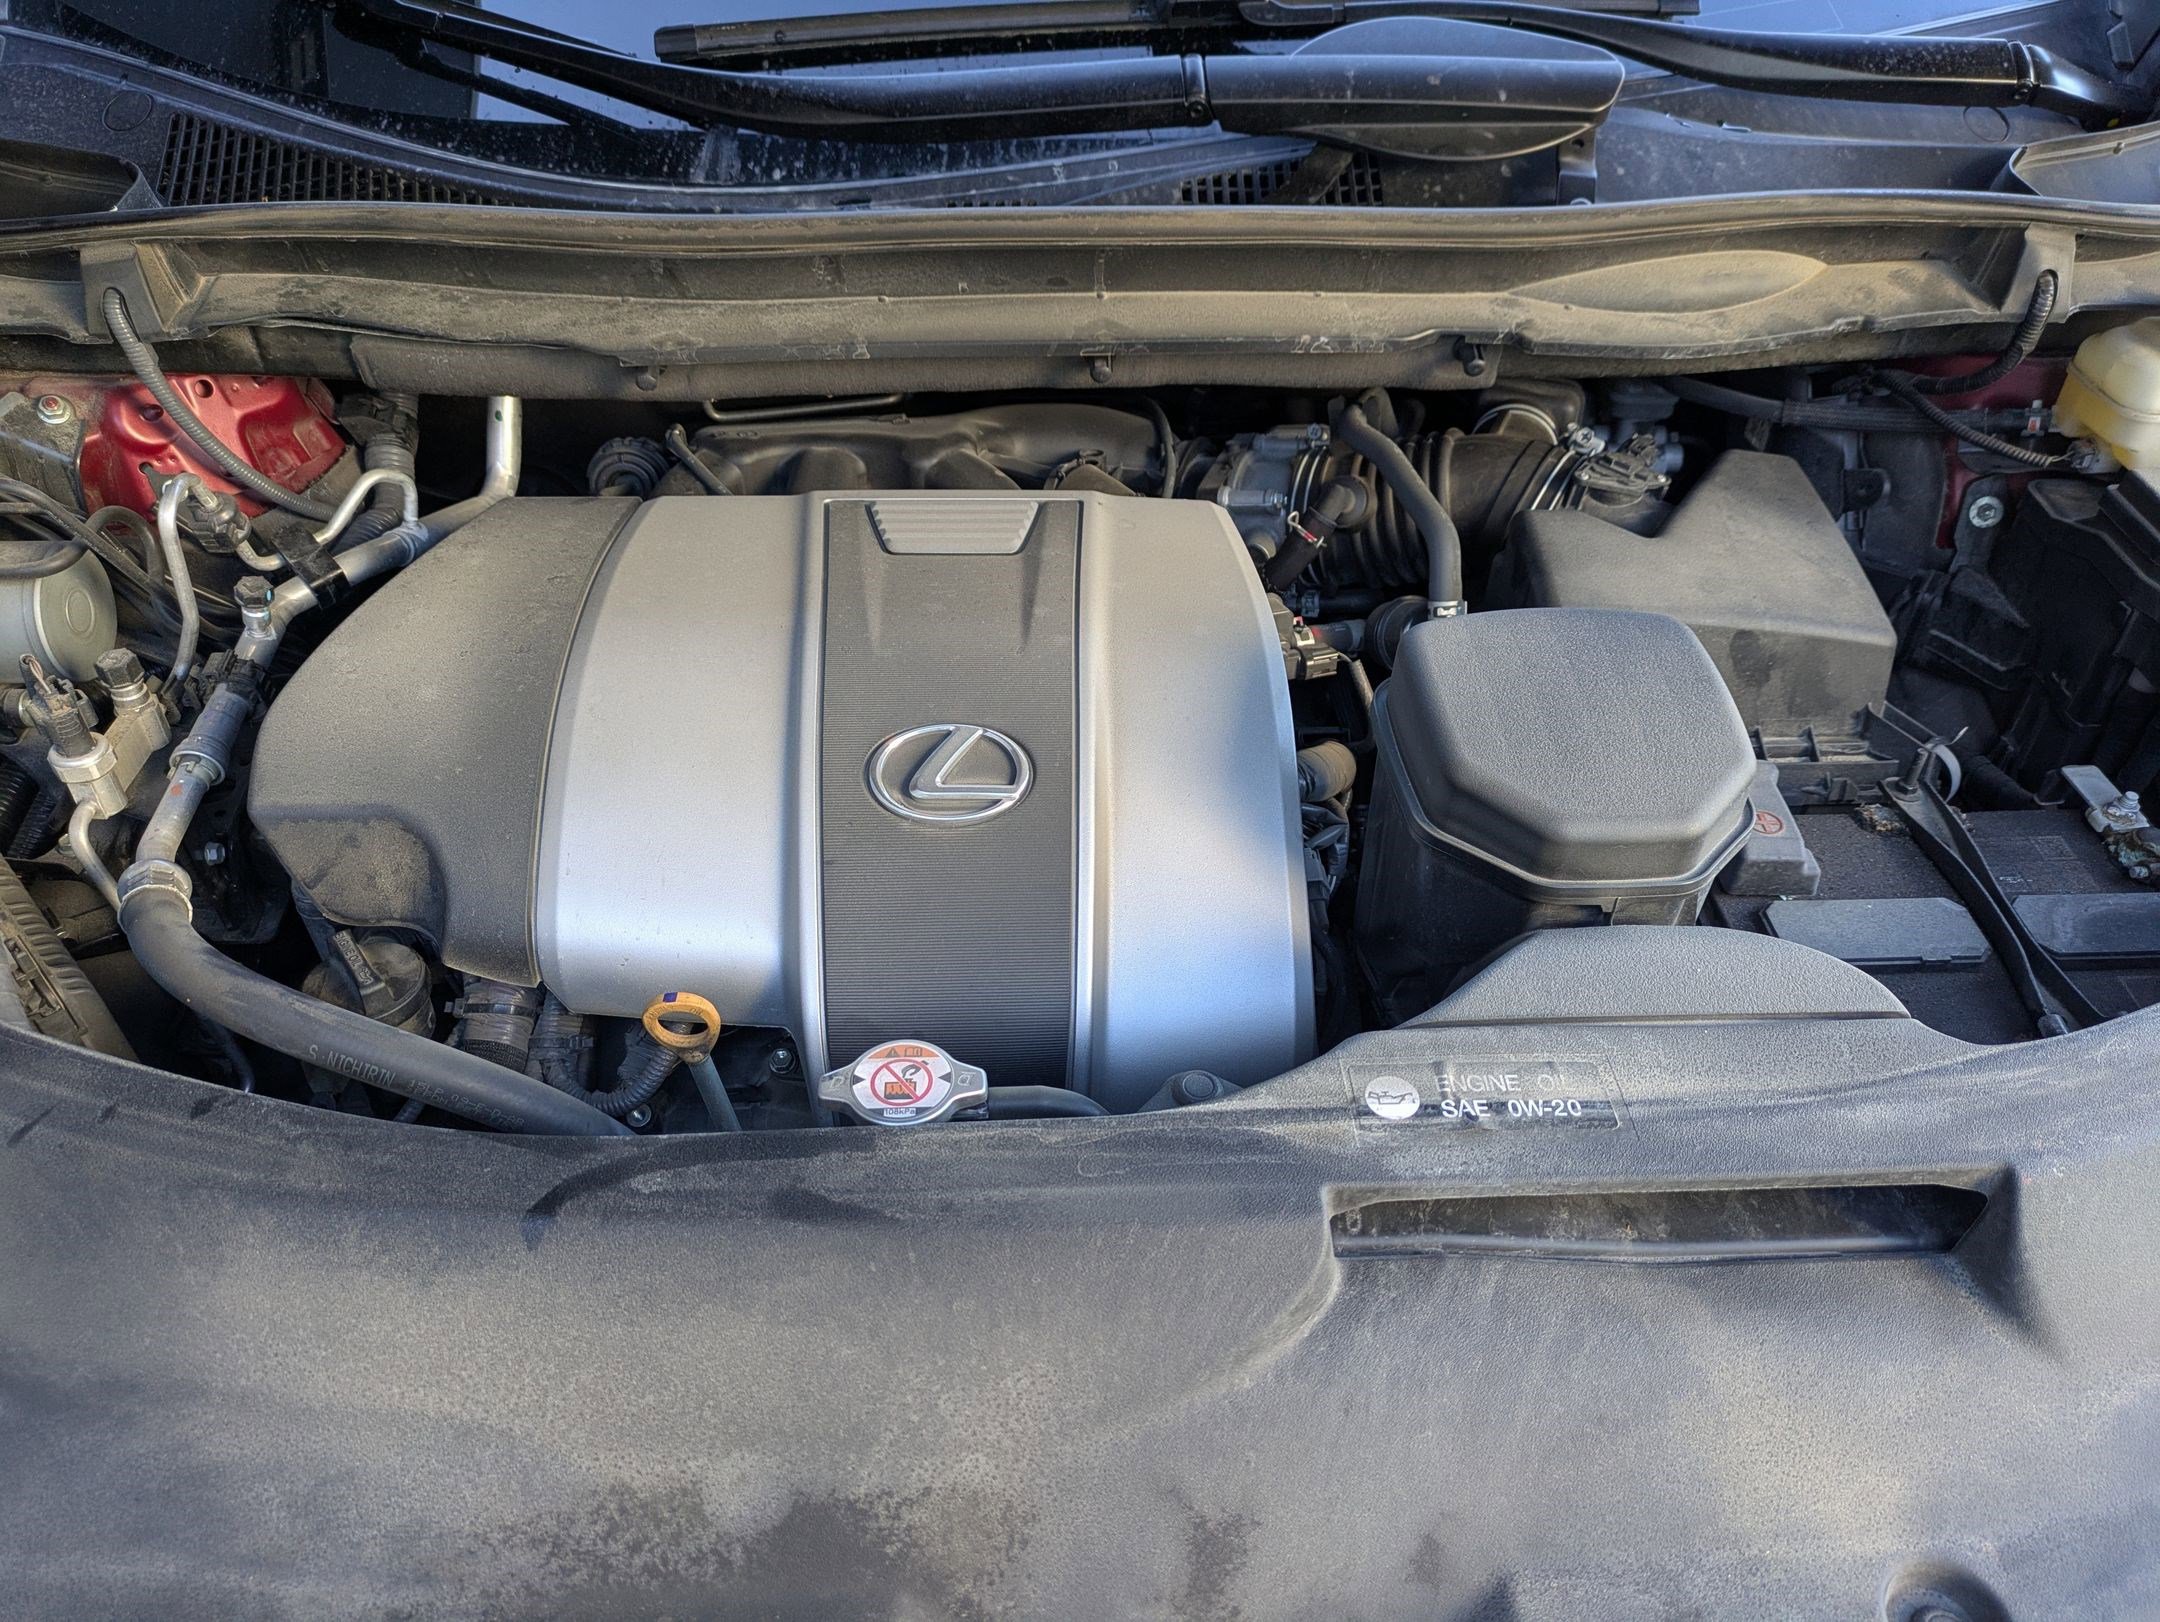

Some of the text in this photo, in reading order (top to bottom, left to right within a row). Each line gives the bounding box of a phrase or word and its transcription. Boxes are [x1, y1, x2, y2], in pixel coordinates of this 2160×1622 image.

[1435, 1073, 1576, 1092] ENGINE OIL
[1440, 1098, 1582, 1118] SAE 0W-20
